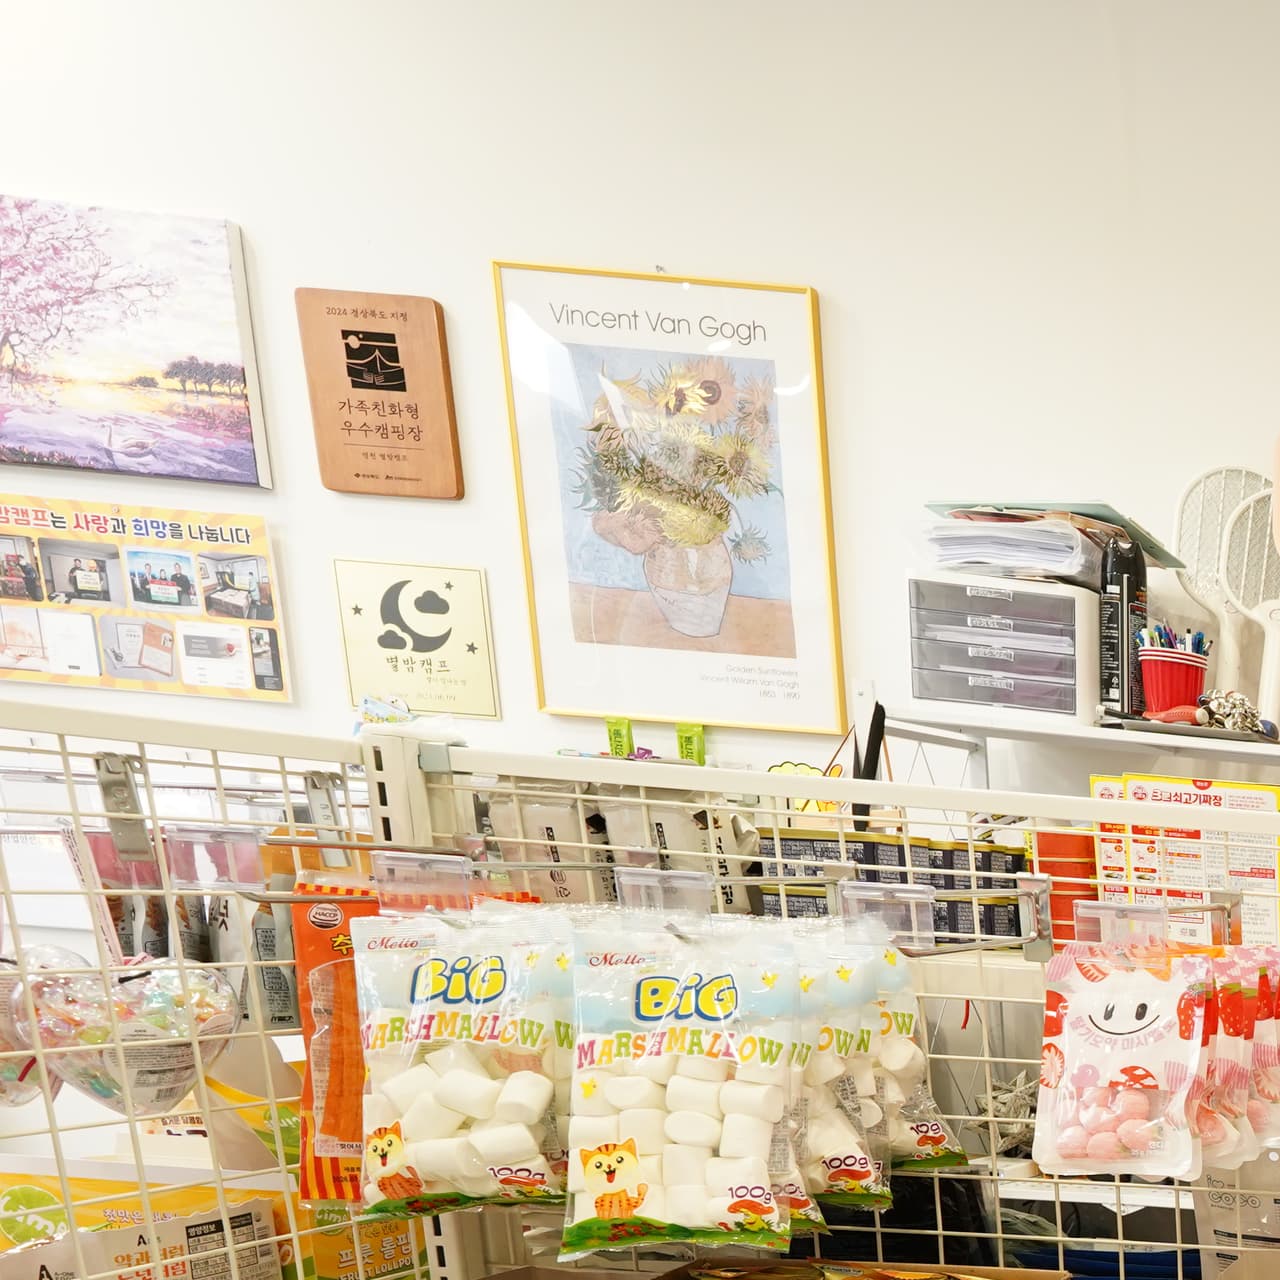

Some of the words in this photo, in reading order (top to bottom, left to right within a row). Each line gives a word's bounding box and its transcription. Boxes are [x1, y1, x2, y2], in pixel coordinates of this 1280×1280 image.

[326, 306, 348, 317] 2024
[548, 302, 641, 336] Vincent
[645, 308, 693, 336] Van
[700, 311, 768, 345] Gogh
[338, 398, 420, 421] 가족친화형
[340, 420, 424, 443] 우수캠핑장
[73, 511, 127, 535] 사랑과
[131, 517, 183, 540] 희망을
[188, 524, 251, 545] 나눕니다
[360, 1012, 541, 1049] MARSHMALLOW
[576, 1030, 784, 1070] MARSHMALLOW
[489, 1165, 546, 1183] 100g
[821, 1154, 869, 1172] 100g
[727, 1184, 773, 1204] 100g
